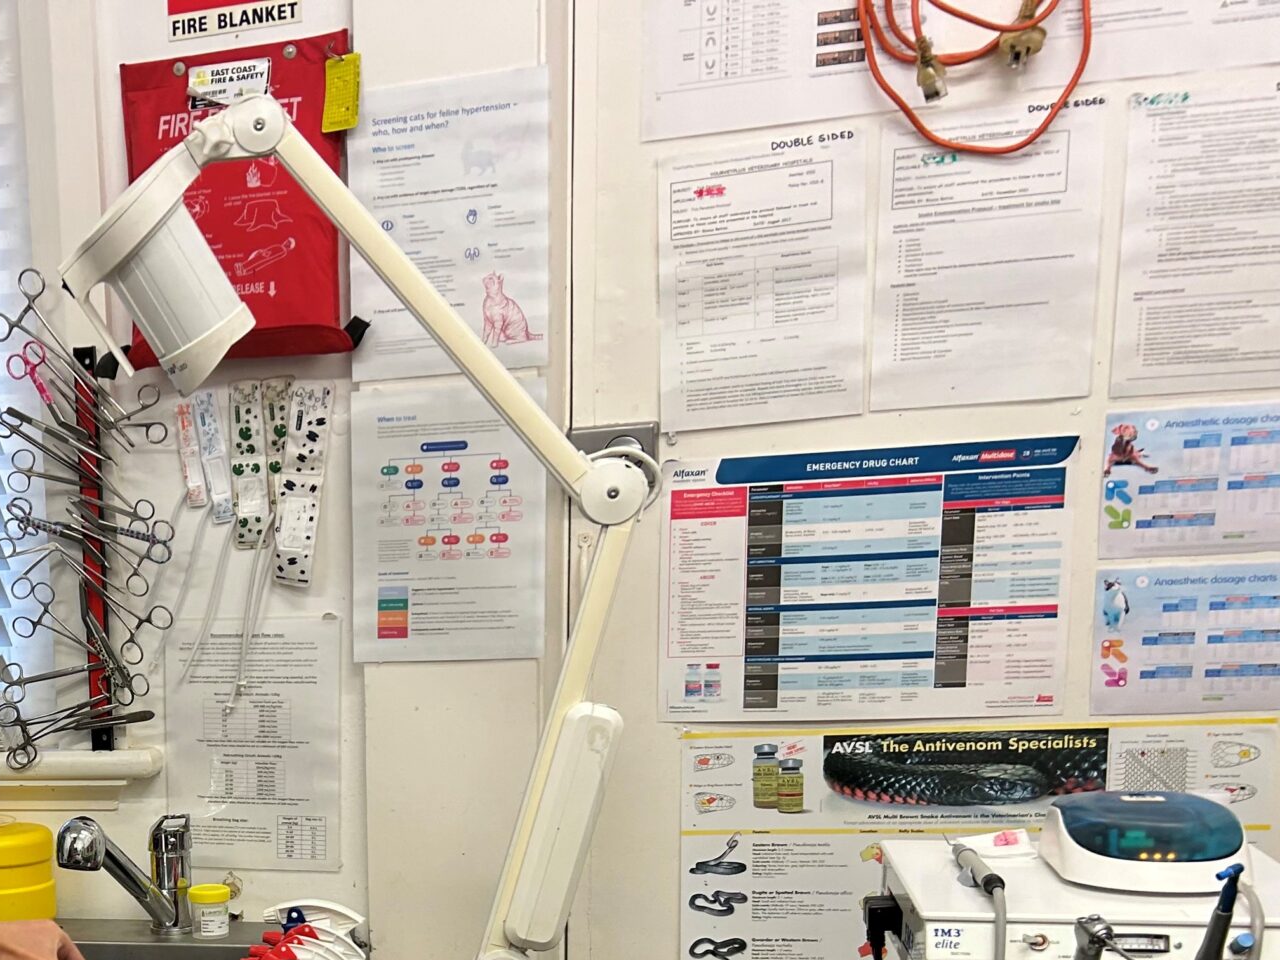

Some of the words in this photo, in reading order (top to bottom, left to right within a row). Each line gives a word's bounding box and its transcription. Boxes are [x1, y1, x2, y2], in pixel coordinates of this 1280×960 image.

[172, 16, 207, 36] FIRE
[217, 3, 297, 30] BLANKET
[211, 68, 228, 77] EAST
[231, 65, 256, 74] COAST
[236, 71, 265, 81] SAFETY
[1073, 97, 1106, 107] SIDED
[372, 115, 408, 126] Screening
[409, 113, 424, 122] cats
[427, 111, 437, 119] for
[439, 108, 459, 117] feline
[461, 102, 511, 116] hypertension
[372, 129, 389, 137] who,
[392, 127, 407, 135] how
[410, 124, 423, 132] and
[425, 120, 449, 130] when?
[771, 136, 813, 151] DOUBLE
[818, 130, 854, 143] SIDED
[1164, 418, 1220, 428] Anaesthetic
[1223, 416, 1258, 426] dosage
[952, 454, 979, 463] Alfaxan
[981, 452, 1015, 460] Multidose
[806, 461, 861, 471] EMERGENCY
[863, 459, 887, 468] DRUG
[889, 457, 919, 466] CHART
[673, 468, 706, 479] Alfaxan
[1154, 576, 1209, 586] Anaesthetic
[1210, 575, 1246, 585] dosage
[1248, 574, 1277, 582] charts
[832, 741, 872, 754] AVSL
[881, 741, 909, 753] The
[913, 738, 1004, 753] Antivenom
[1008, 736, 1097, 753] Specialists
[935, 939, 960, 949] elite
